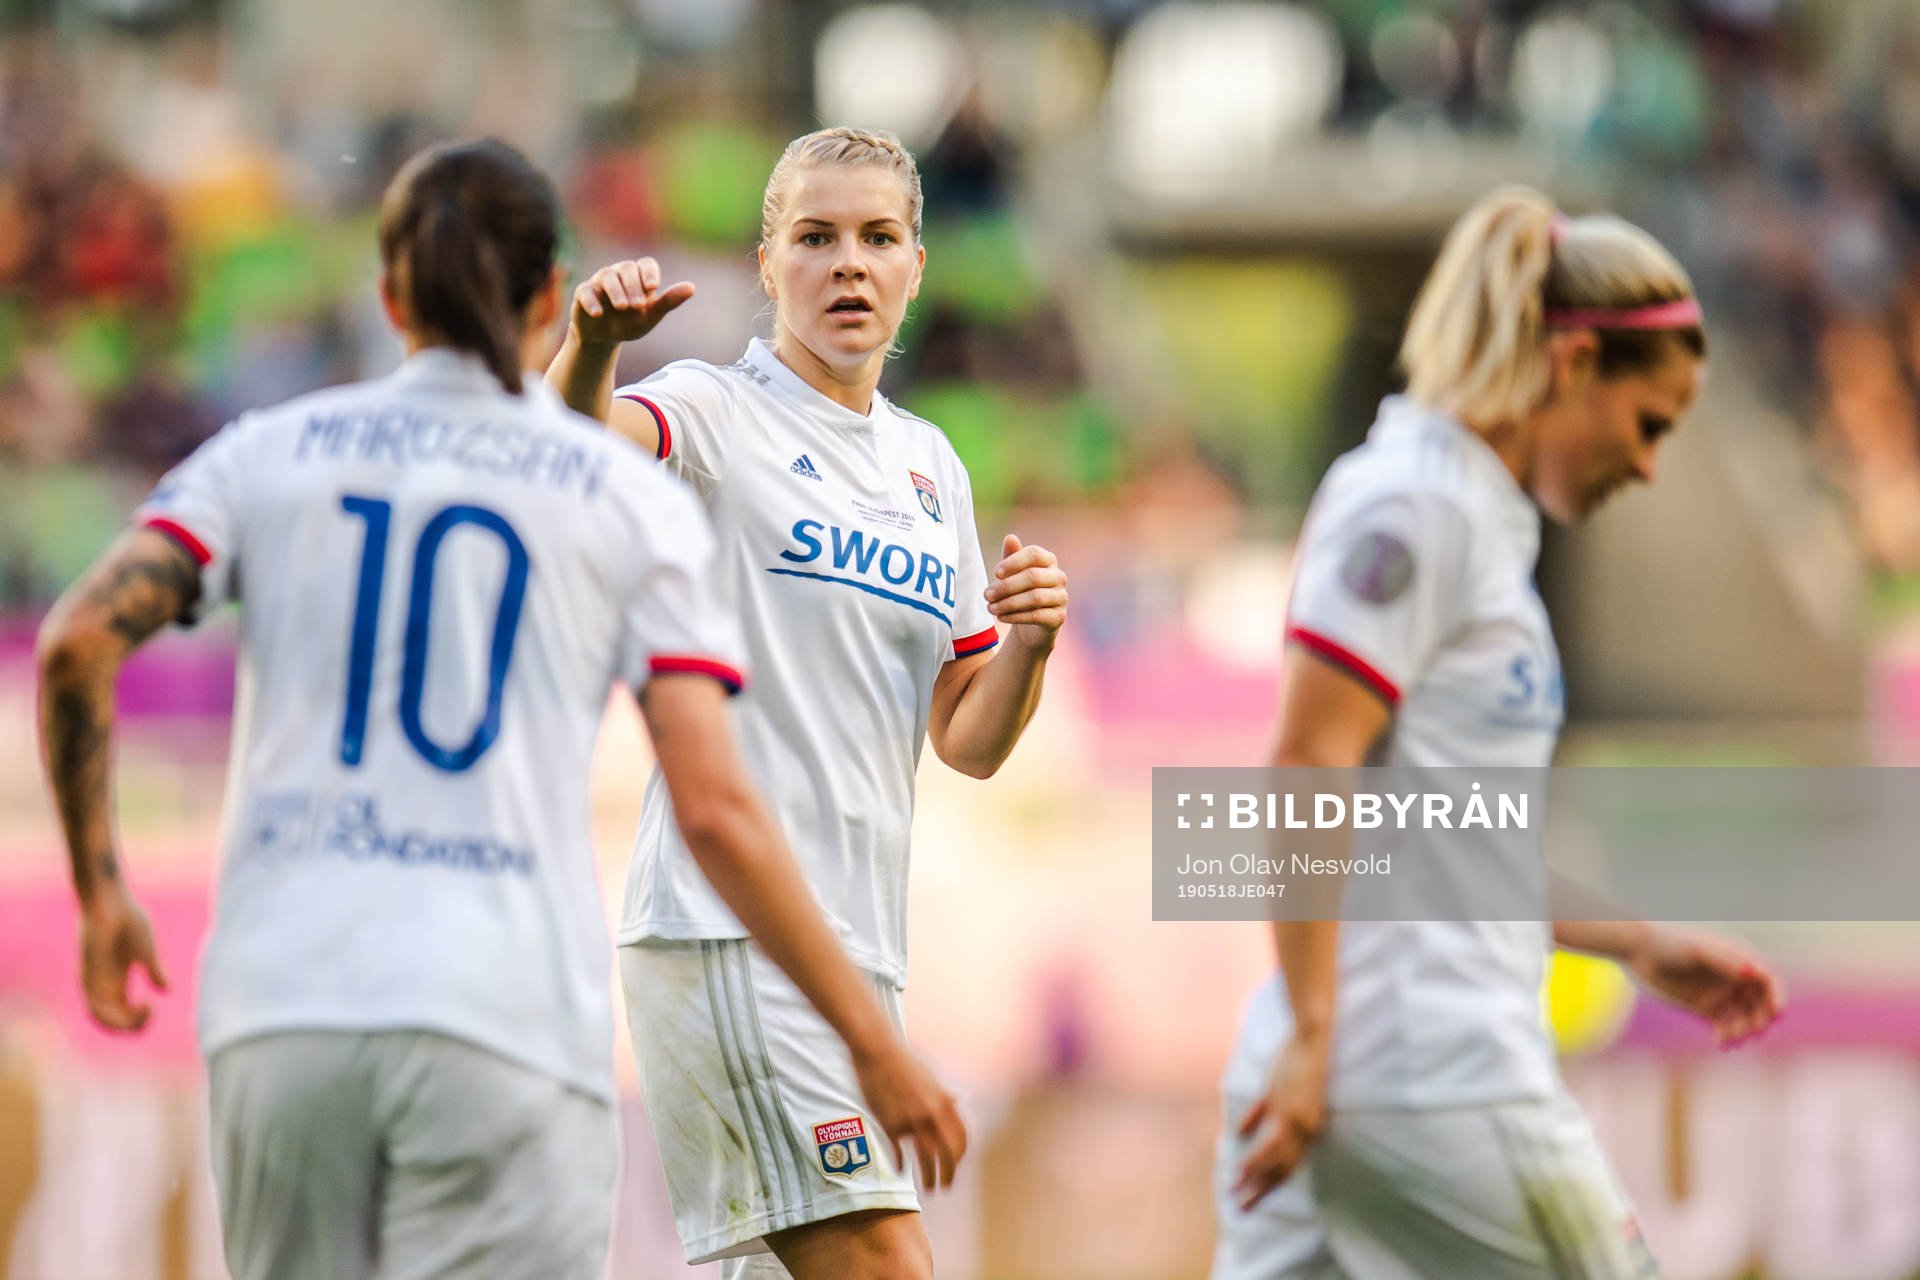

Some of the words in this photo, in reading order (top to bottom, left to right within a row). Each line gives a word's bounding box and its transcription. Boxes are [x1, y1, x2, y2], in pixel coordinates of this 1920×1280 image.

[790, 466, 823, 482] adidas
[779, 518, 956, 609] SWORD
[341, 496, 529, 772] 10
[817, 1120, 859, 1136] OLYMPIQUE
[819, 1127, 862, 1143] LYONNAIS
